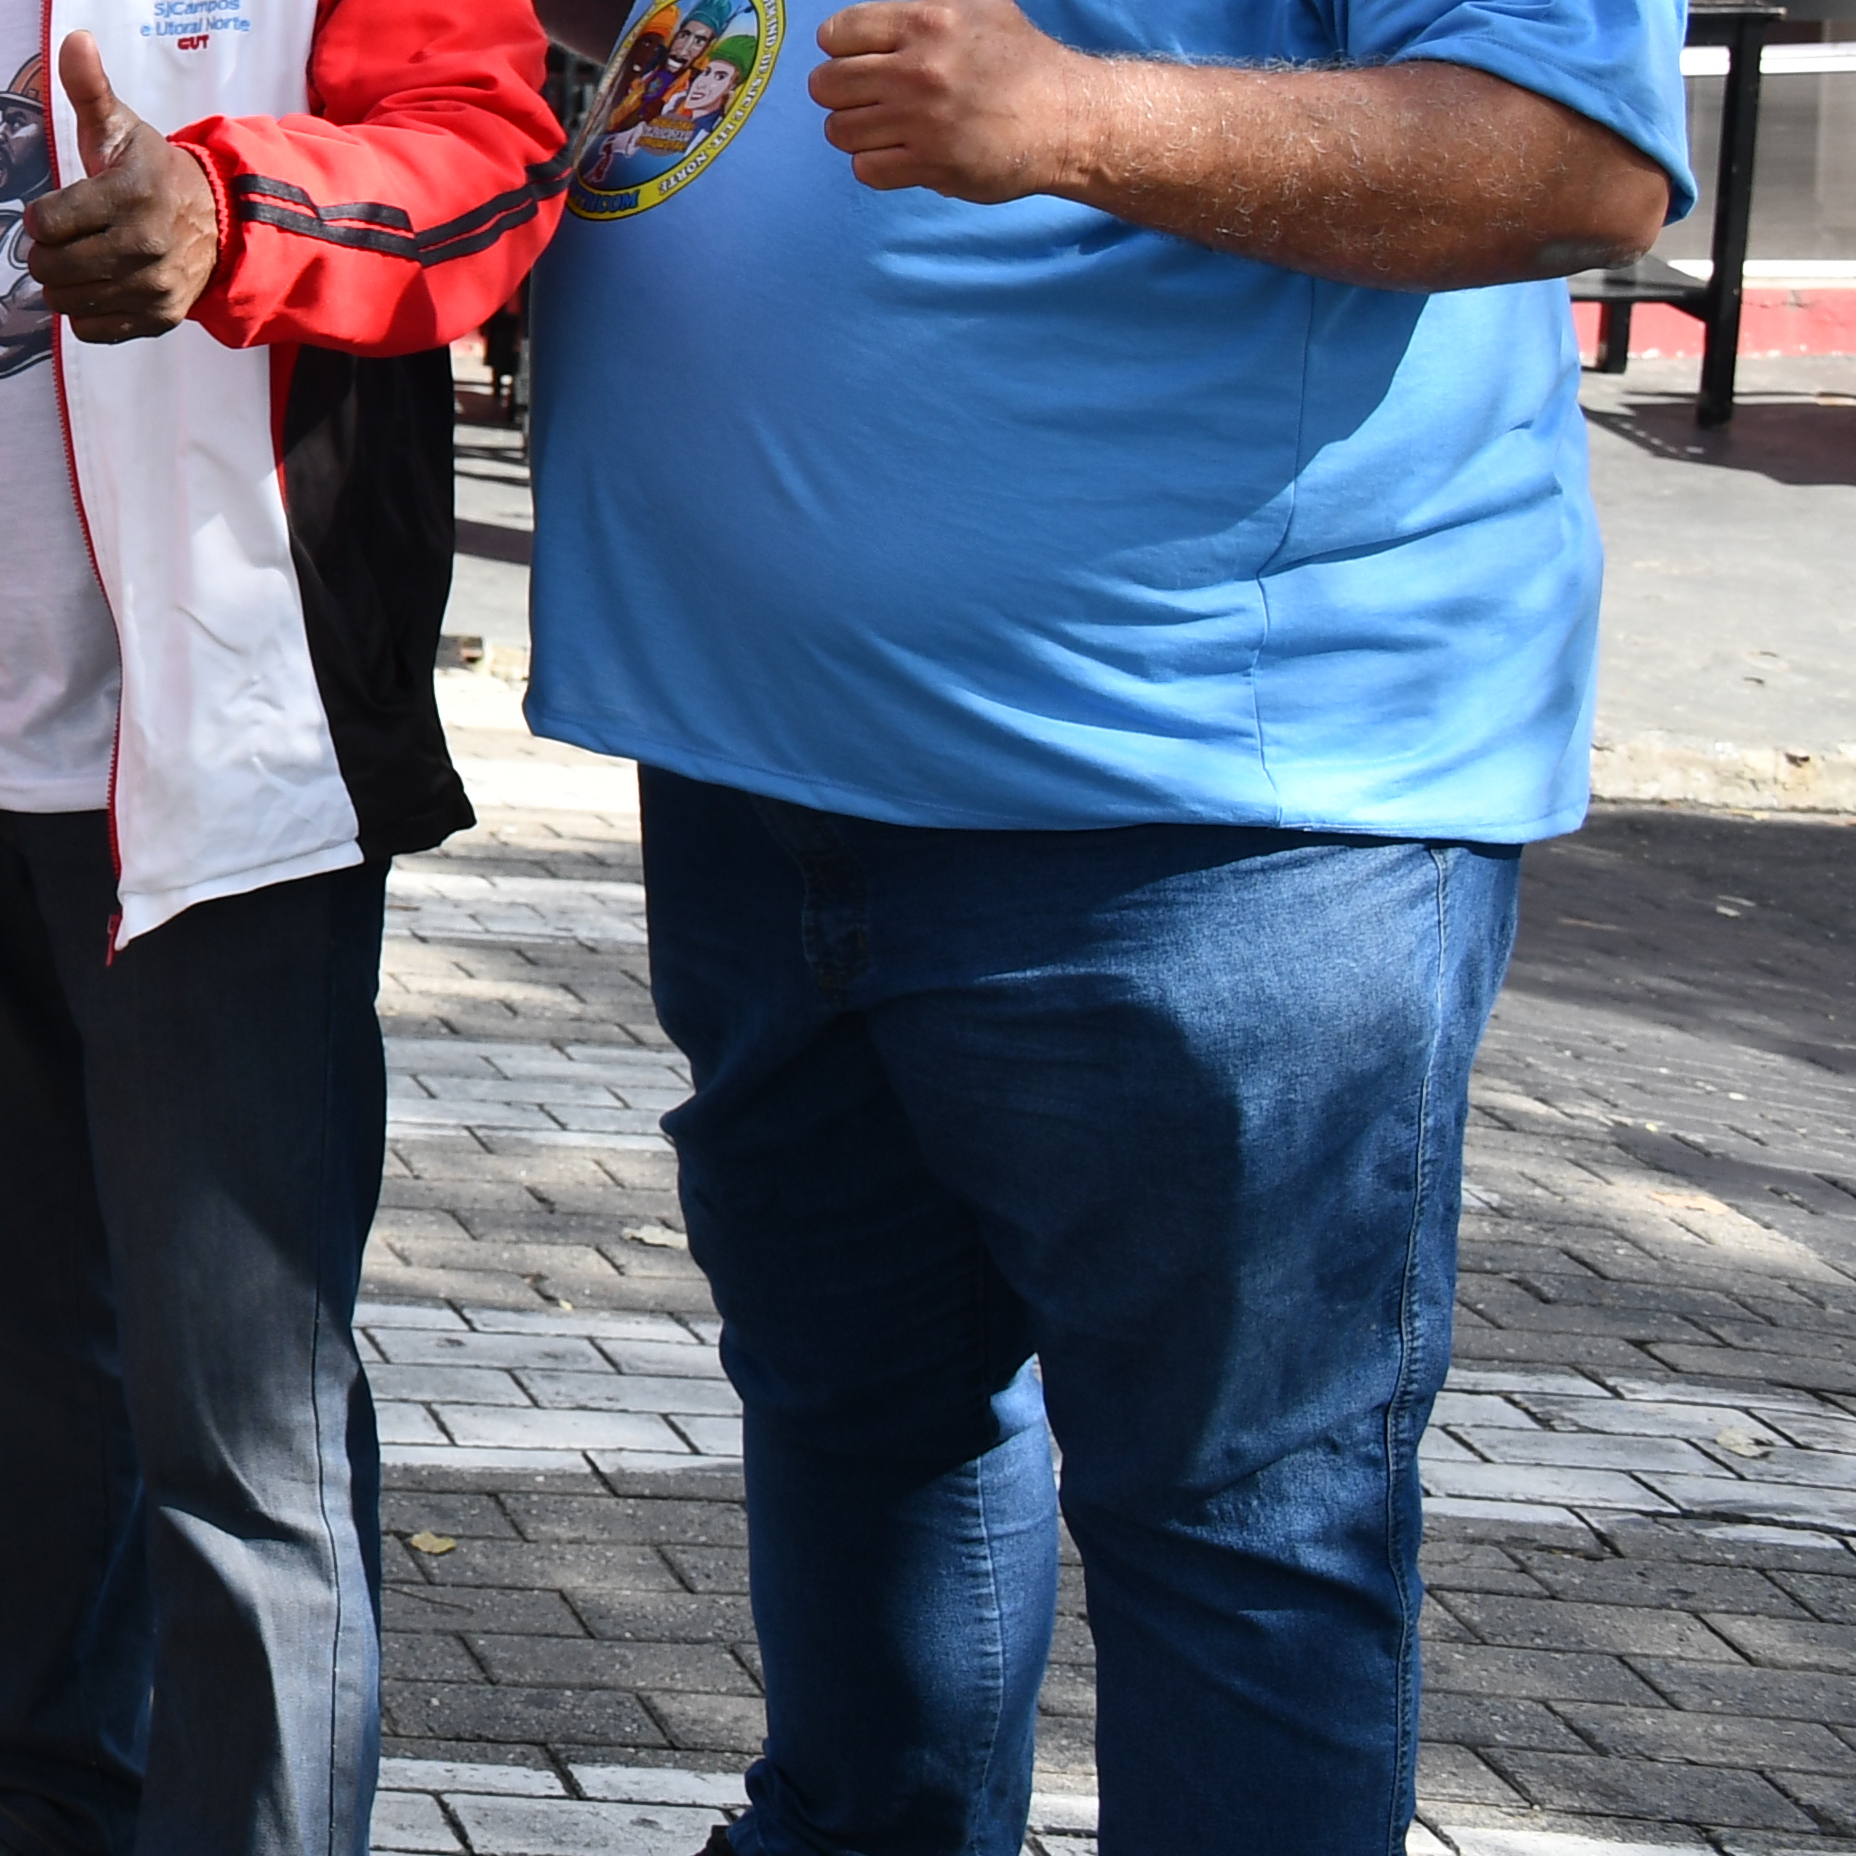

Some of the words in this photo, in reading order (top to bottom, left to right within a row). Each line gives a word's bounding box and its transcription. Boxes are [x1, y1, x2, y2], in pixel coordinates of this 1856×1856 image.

[140, 25, 152, 37] e
[205, 17, 251, 34] Norte
[177, 34, 210, 51] CUT
